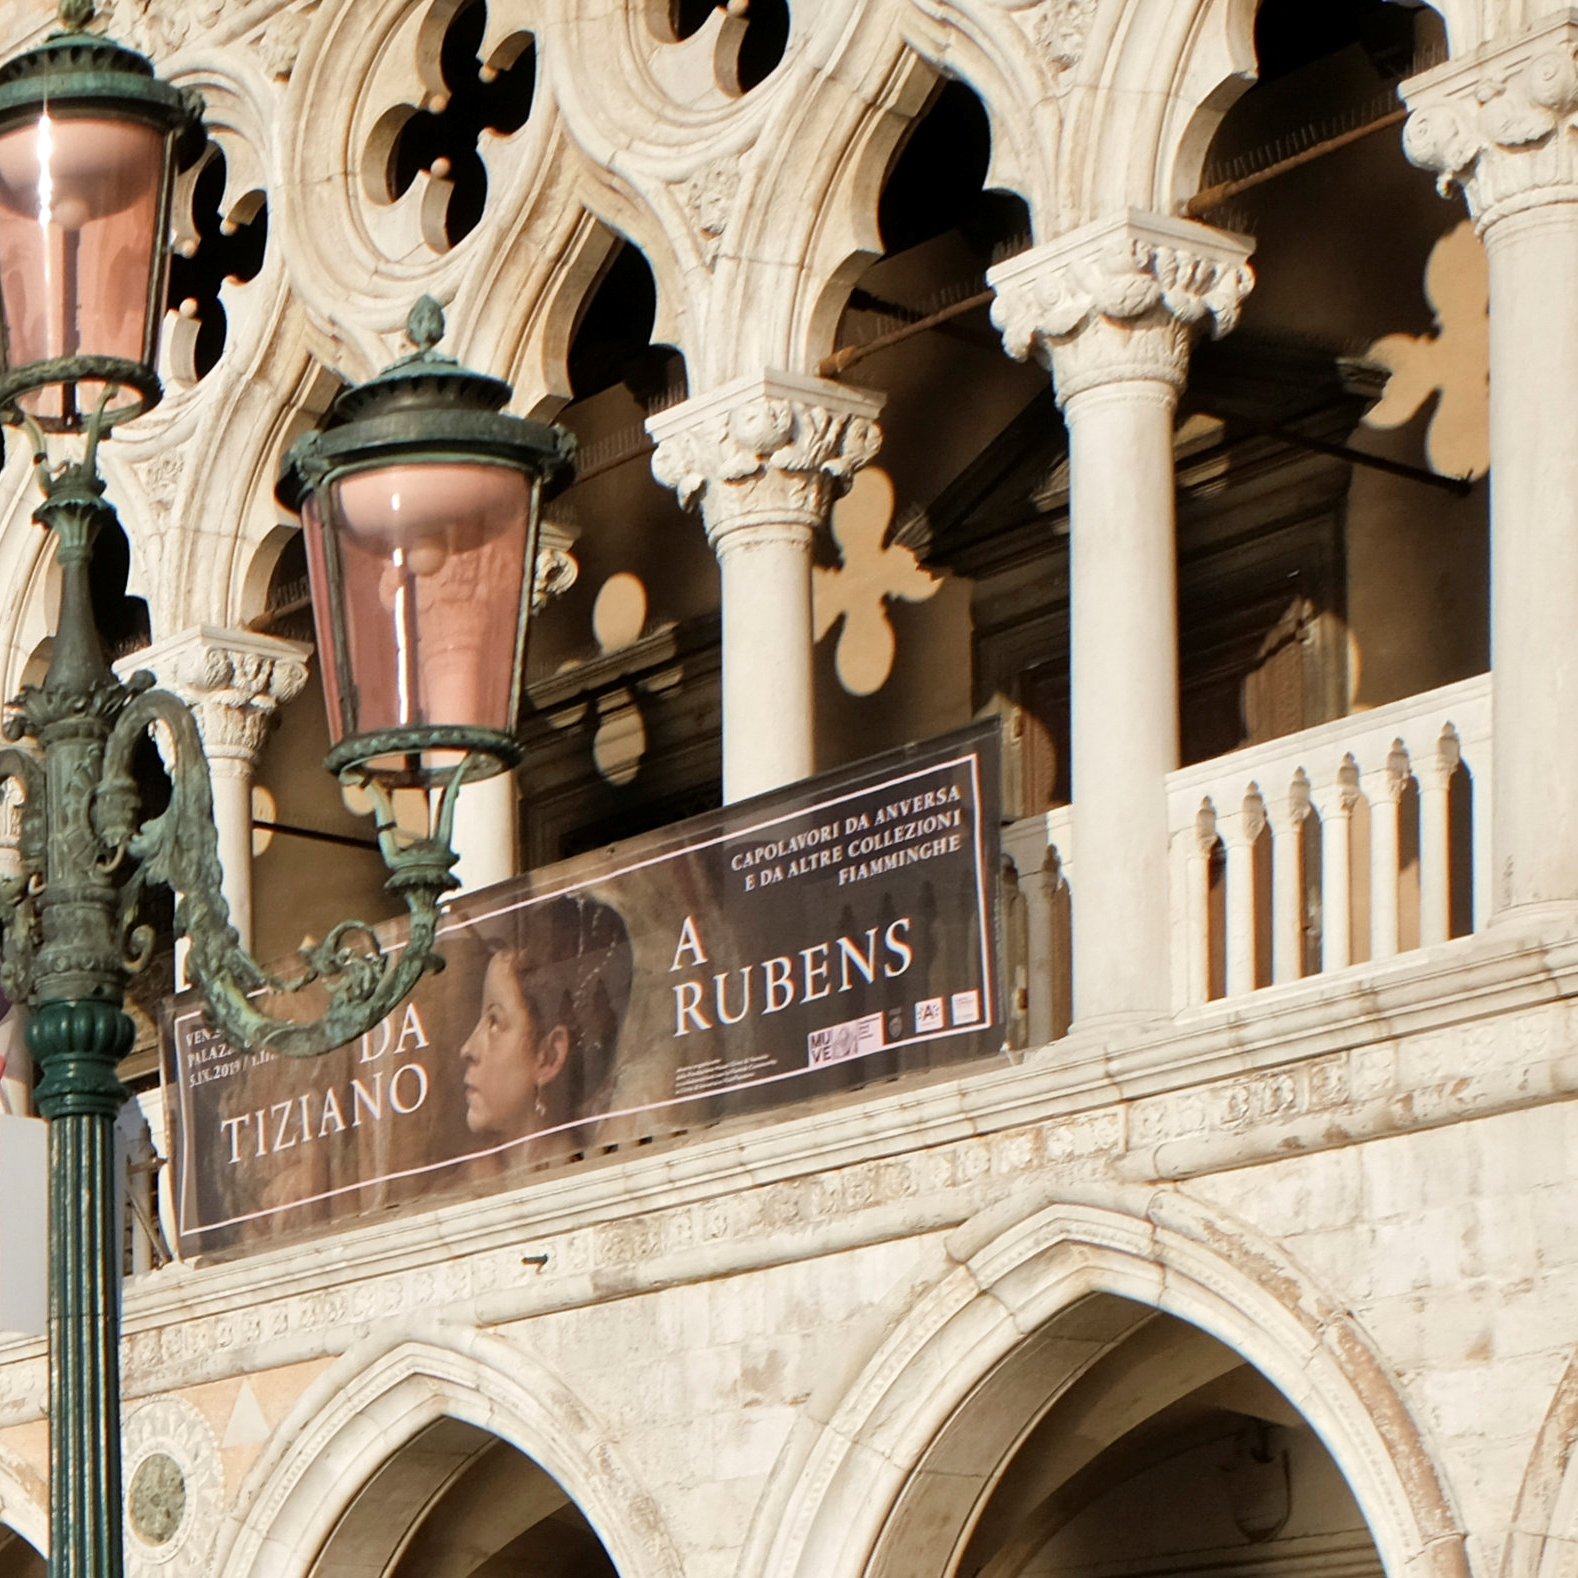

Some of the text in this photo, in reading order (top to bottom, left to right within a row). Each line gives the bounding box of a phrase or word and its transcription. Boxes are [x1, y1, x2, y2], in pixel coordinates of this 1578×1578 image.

[731, 784, 961, 871] CAPOLAVORI DA ANVERSA
[744, 808, 961, 892] E DA ALTRE COLLEZIONI
[838, 834, 961, 886] FIAMMINGHE
[669, 915, 709, 973] A
[672, 917, 914, 1037] RUBENS
[360, 1002, 430, 1064] DA
[220, 1063, 429, 1165] TIZIANO
